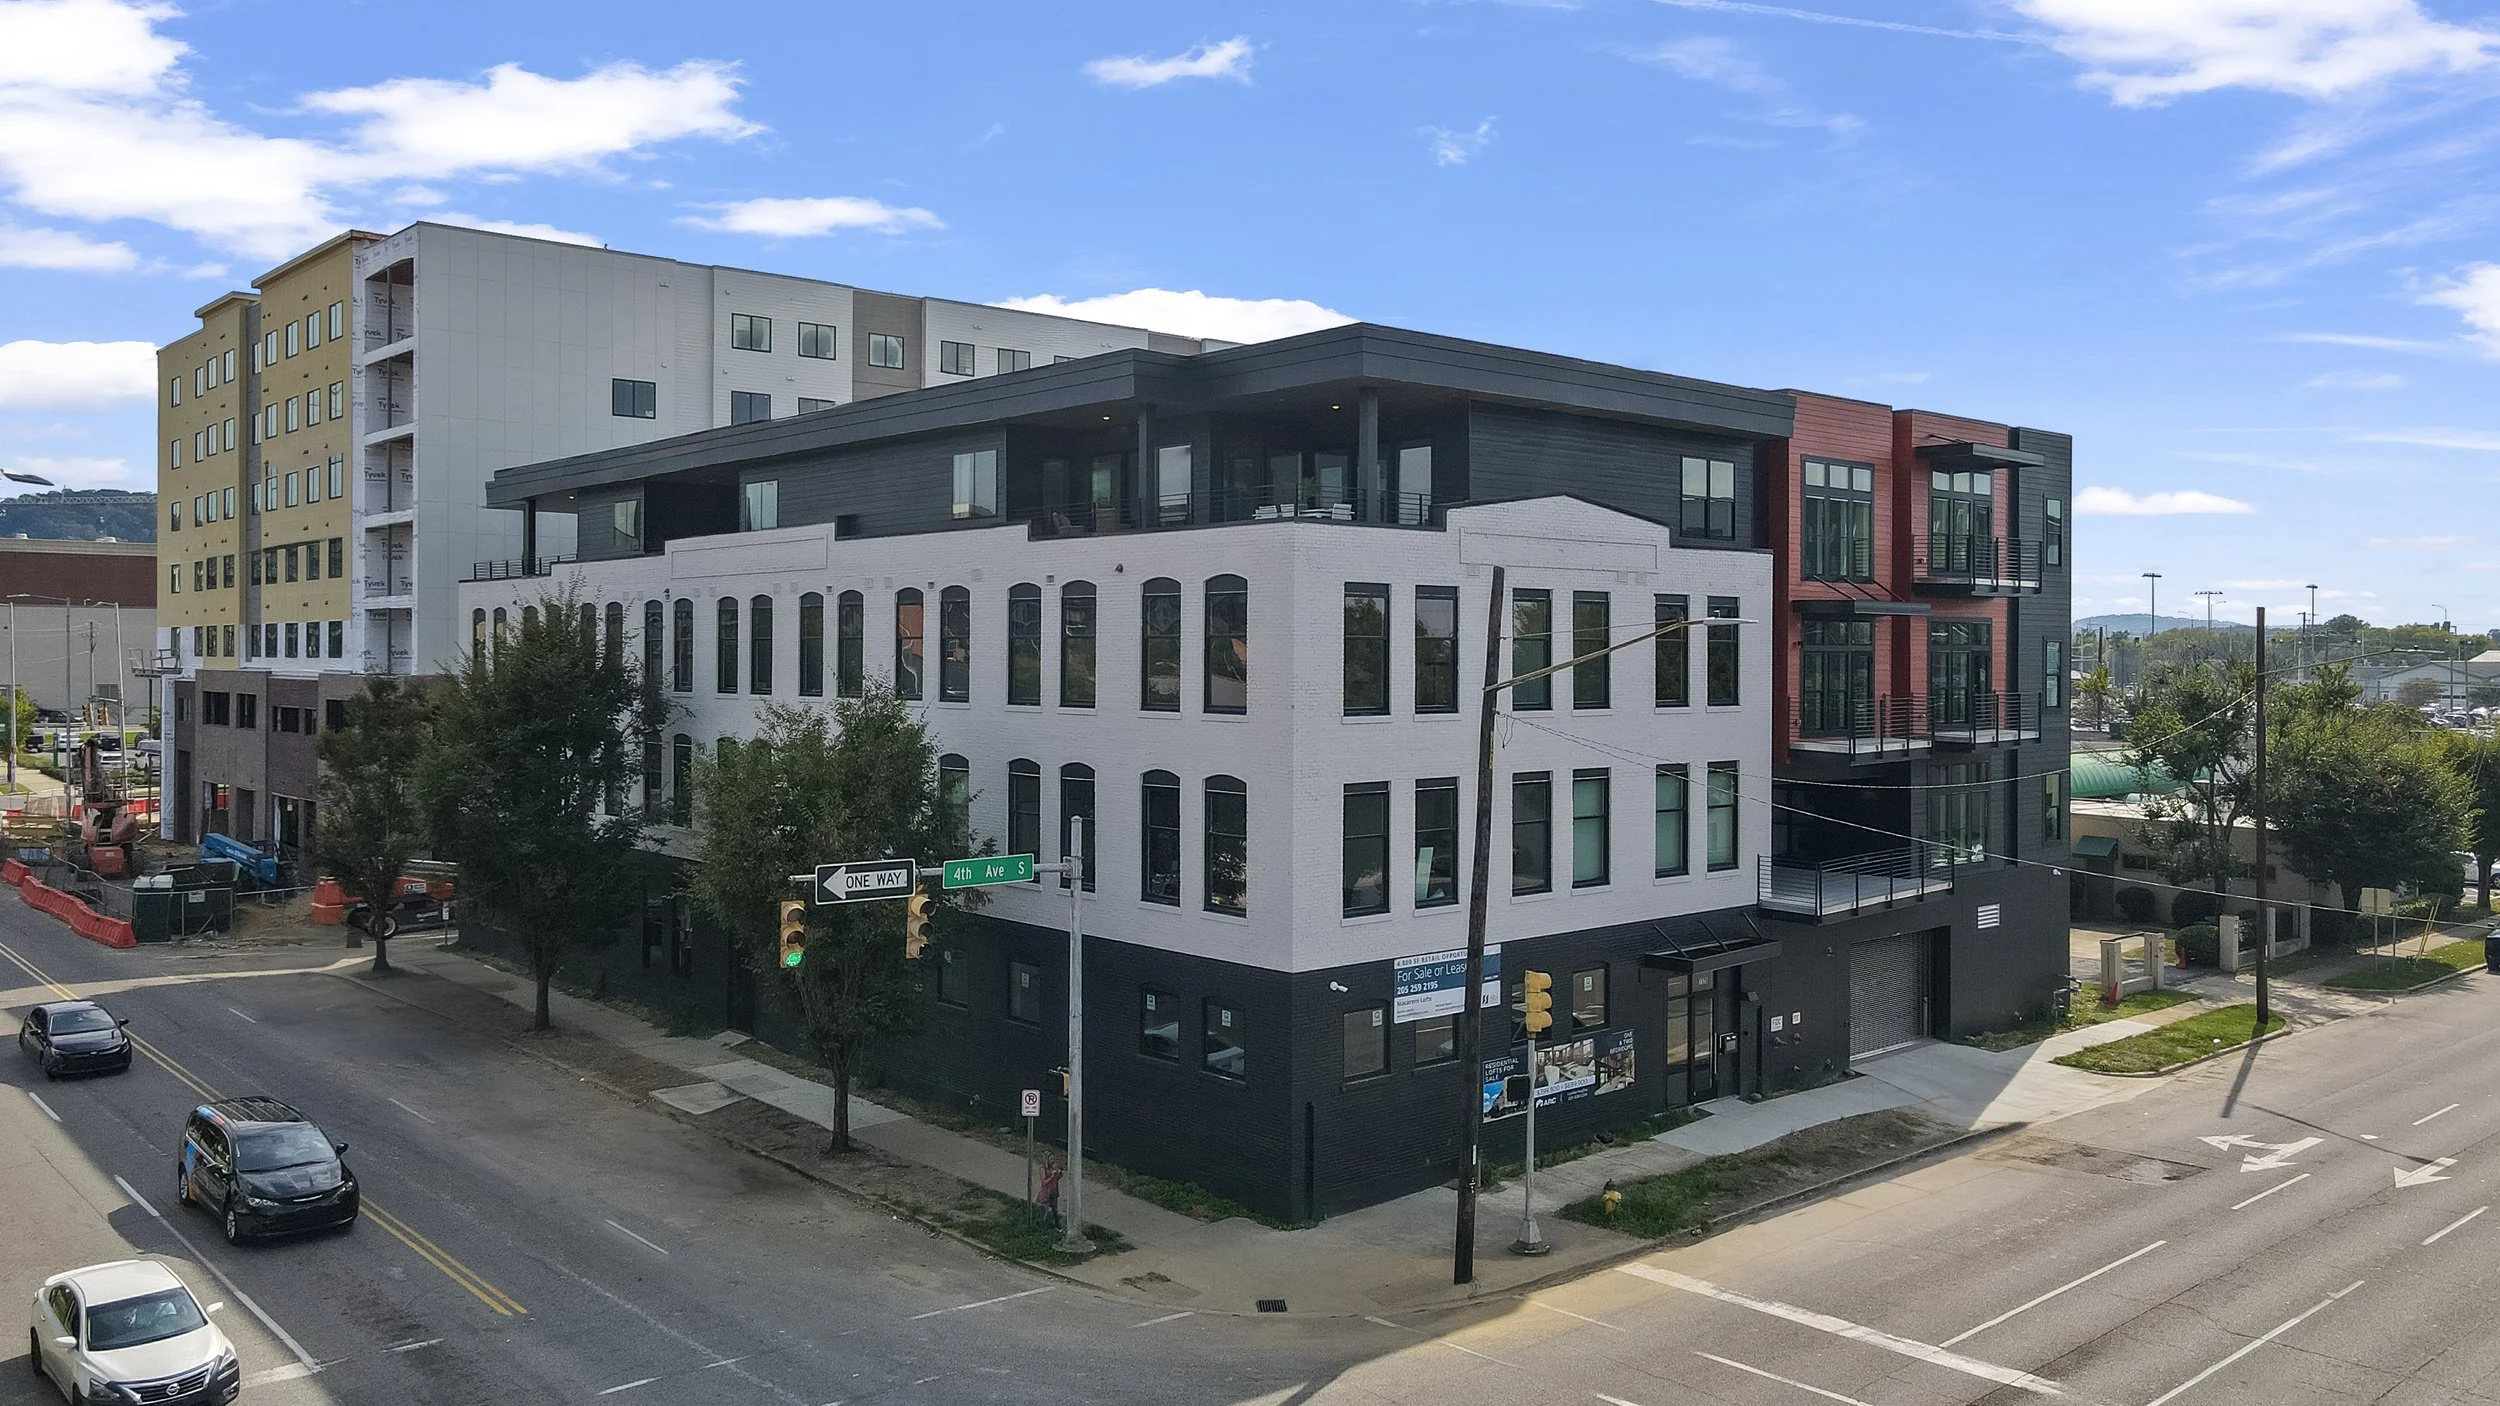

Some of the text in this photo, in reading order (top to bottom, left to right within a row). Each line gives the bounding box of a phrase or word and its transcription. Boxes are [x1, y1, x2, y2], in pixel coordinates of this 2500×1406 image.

[378, 401, 400, 410] Tyek
[364, 471, 386, 479] Tyvek
[364, 580, 385, 588] Tyvek
[953, 861, 1025, 880] 4th Ave S
[845, 872, 902, 889] ONE WAY
[1397, 970, 1413, 982] For
[1414, 966, 1432, 980] Sale
[1434, 966, 1444, 977] or
[1397, 981, 1438, 995] 205 259 2195
[1485, 1057, 1519, 1069] RESIDENTIAL
[1485, 1064, 1514, 1076] LOFTS FOR
[1485, 1074, 1499, 1083] SALE
